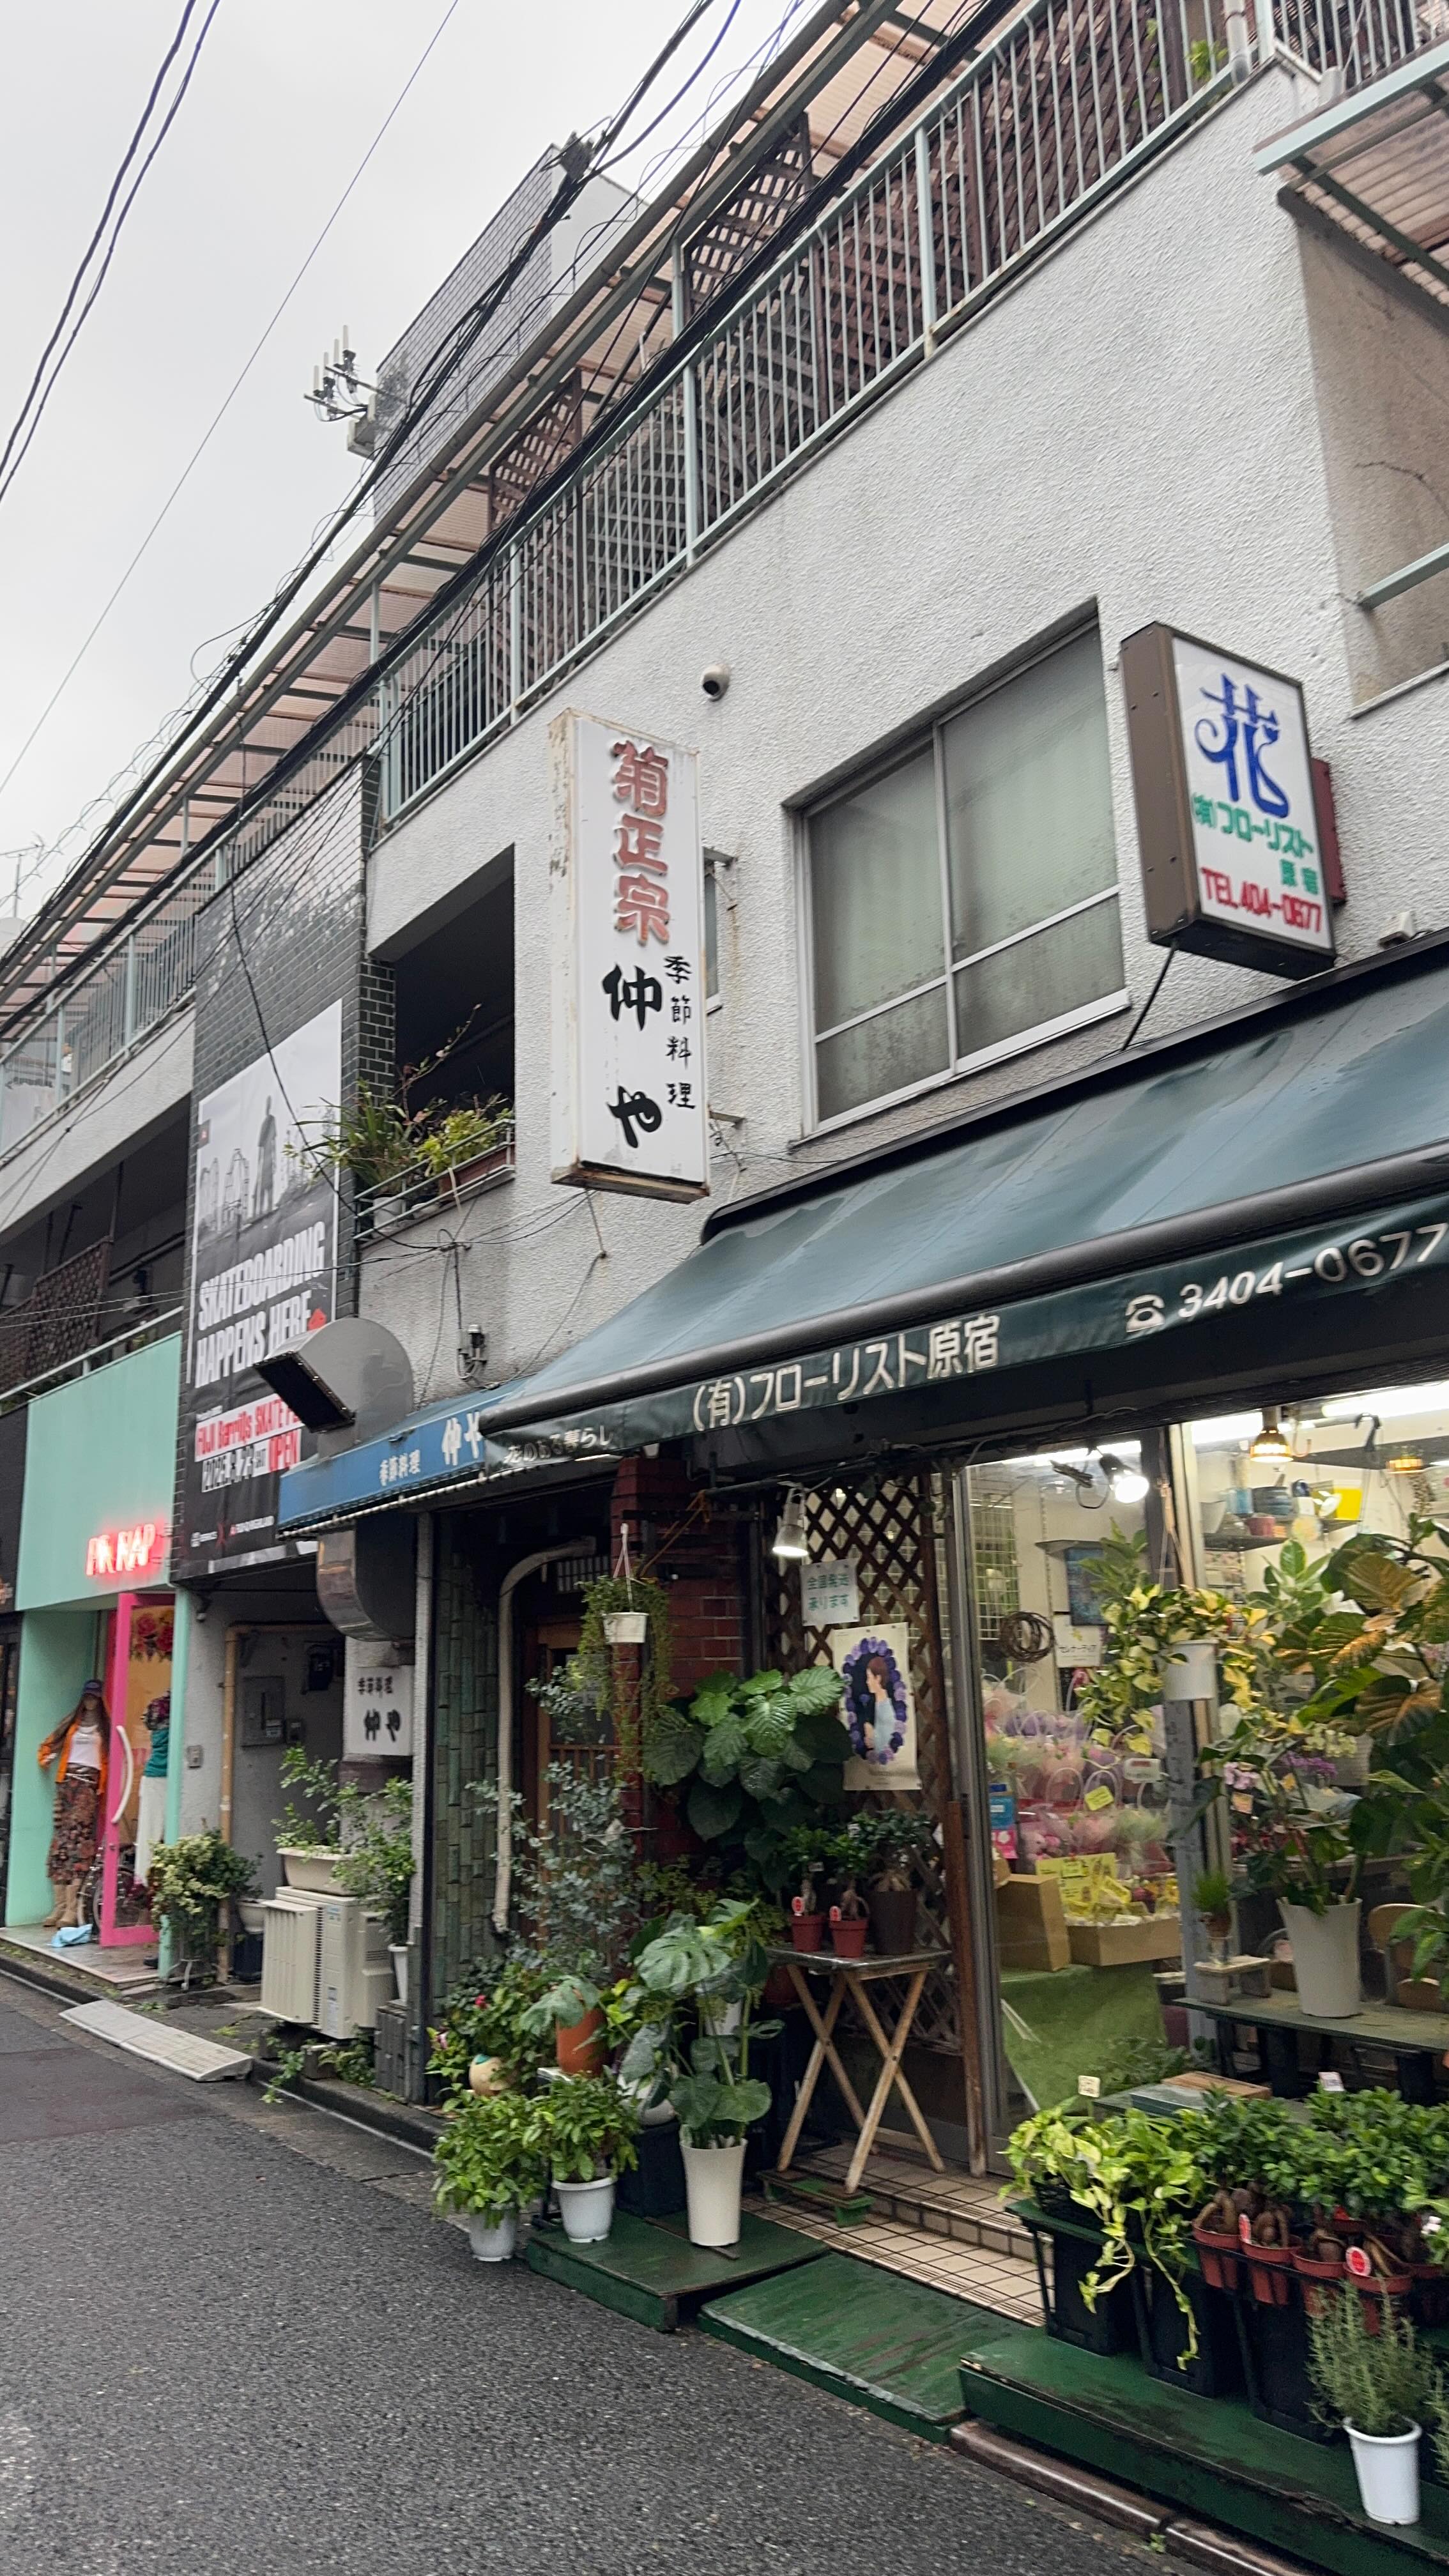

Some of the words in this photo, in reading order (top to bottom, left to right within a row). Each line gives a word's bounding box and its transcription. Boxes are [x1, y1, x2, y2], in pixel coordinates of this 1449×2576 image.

[612, 740, 669, 946] 菊正宗
[602, 963, 663, 1149] 仲や
[663, 956, 697, 1110] 季節料理
[197, 1220, 326, 1331] SKATEBOARDING
[1179, 1223, 1449, 1319] 3404-0677
[194, 1311, 266, 1389] HAPPENS
[692, 1313, 1002, 1432] (有)フローリスト原宿
[268, 1429, 300, 1473] OPEN
